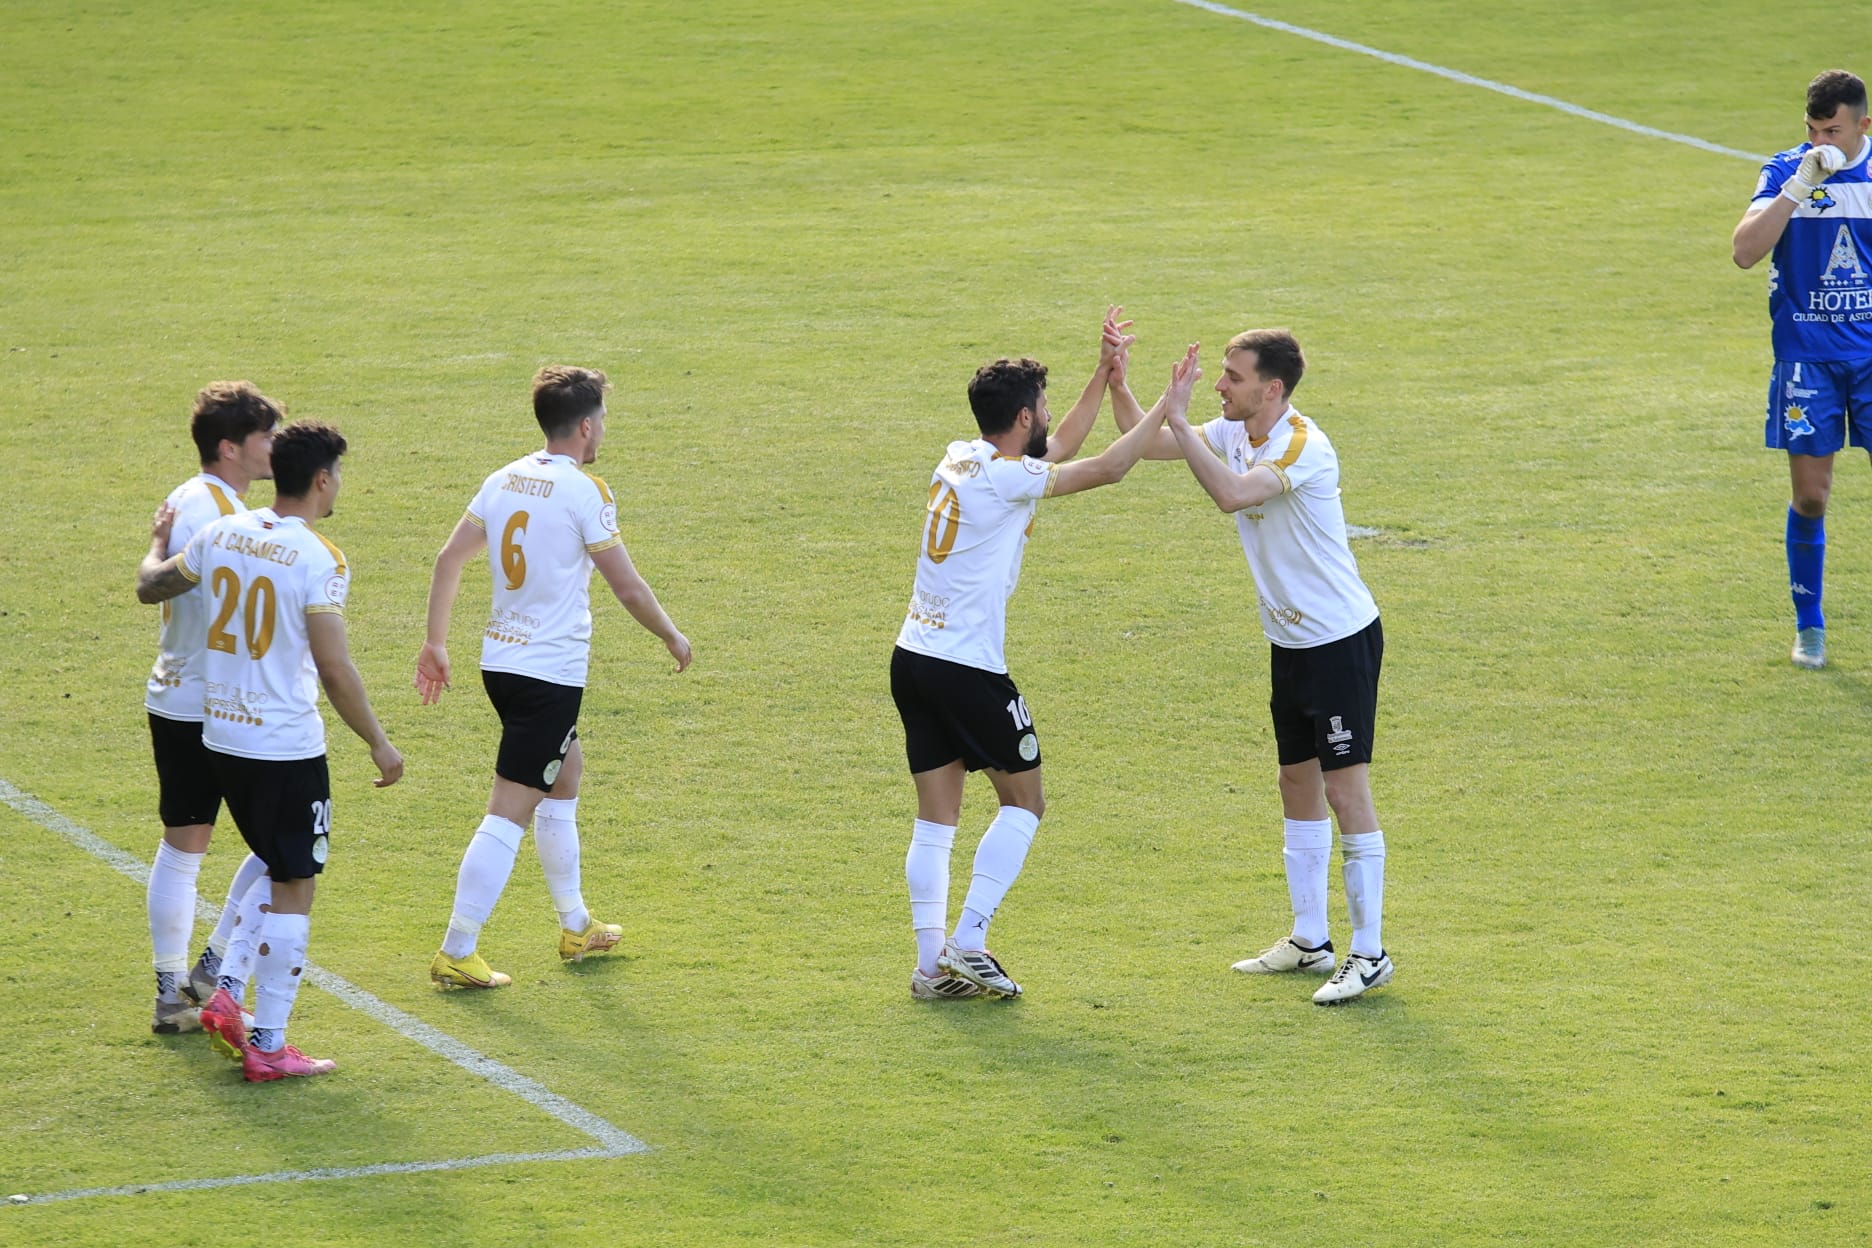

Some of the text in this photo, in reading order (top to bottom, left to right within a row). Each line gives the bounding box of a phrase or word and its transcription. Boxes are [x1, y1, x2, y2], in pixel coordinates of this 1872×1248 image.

[1792, 312, 1828, 322] CIUDAD
[1831, 313, 1845, 323] DE
[225, 532, 298, 566] CARAMELO
[501, 510, 530, 591] 6
[207, 566, 276, 661] 20
[1006, 695, 1032, 731] 10
[312, 798, 331, 835] 20
